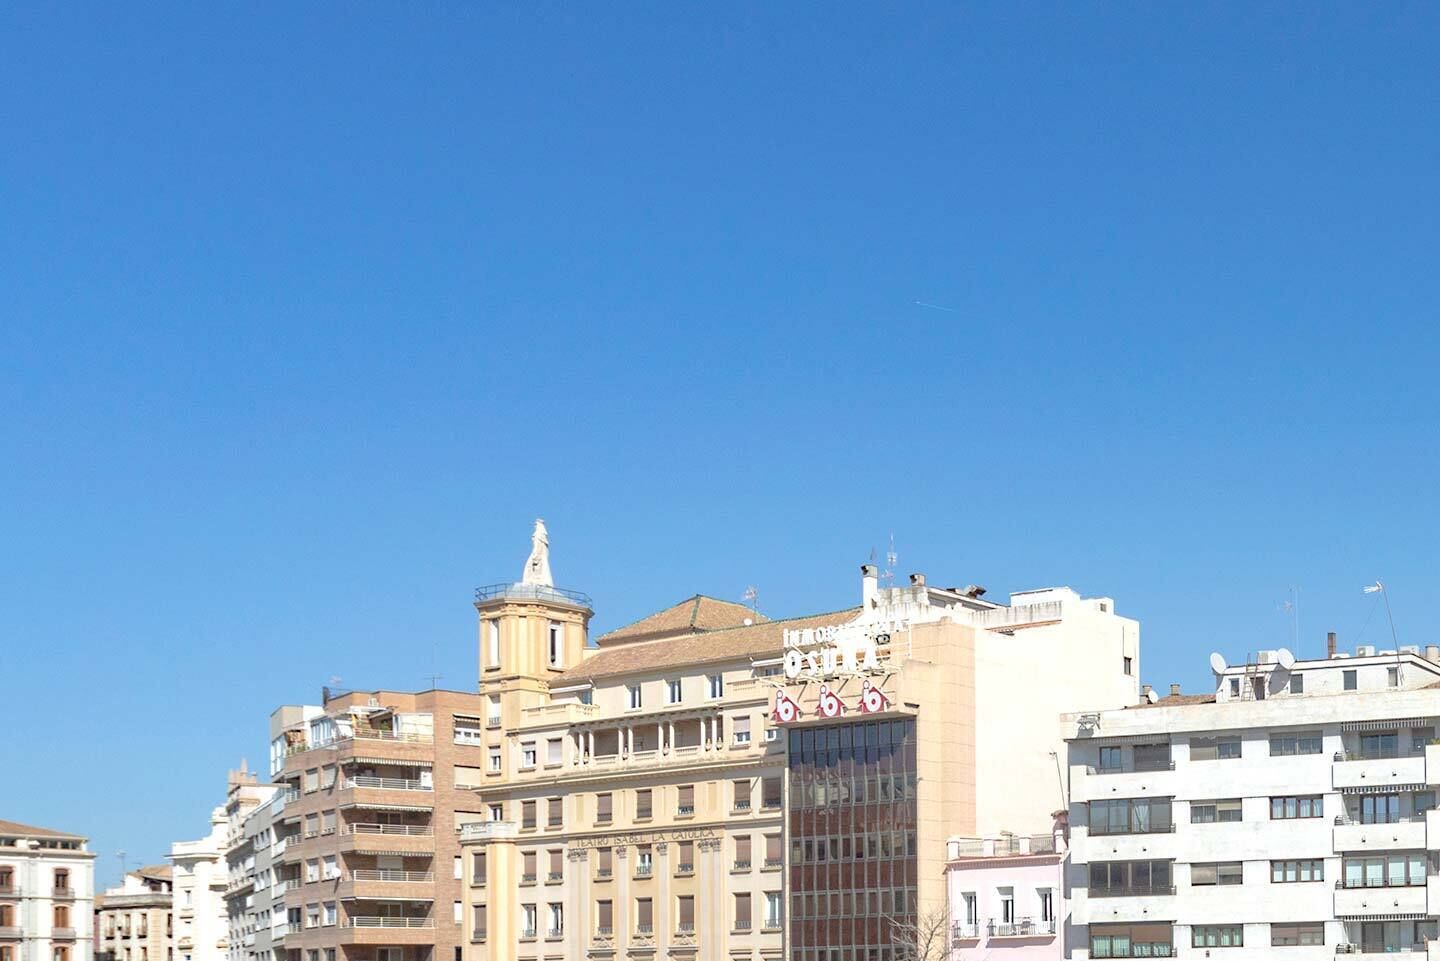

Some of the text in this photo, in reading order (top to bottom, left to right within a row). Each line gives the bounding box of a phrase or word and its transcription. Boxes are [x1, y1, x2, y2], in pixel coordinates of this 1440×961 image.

[784, 644, 880, 678] OSUNA
[576, 837, 608, 848] TEATRO
[613, 834, 645, 844] ISABEL
[652, 833, 665, 842] LA
